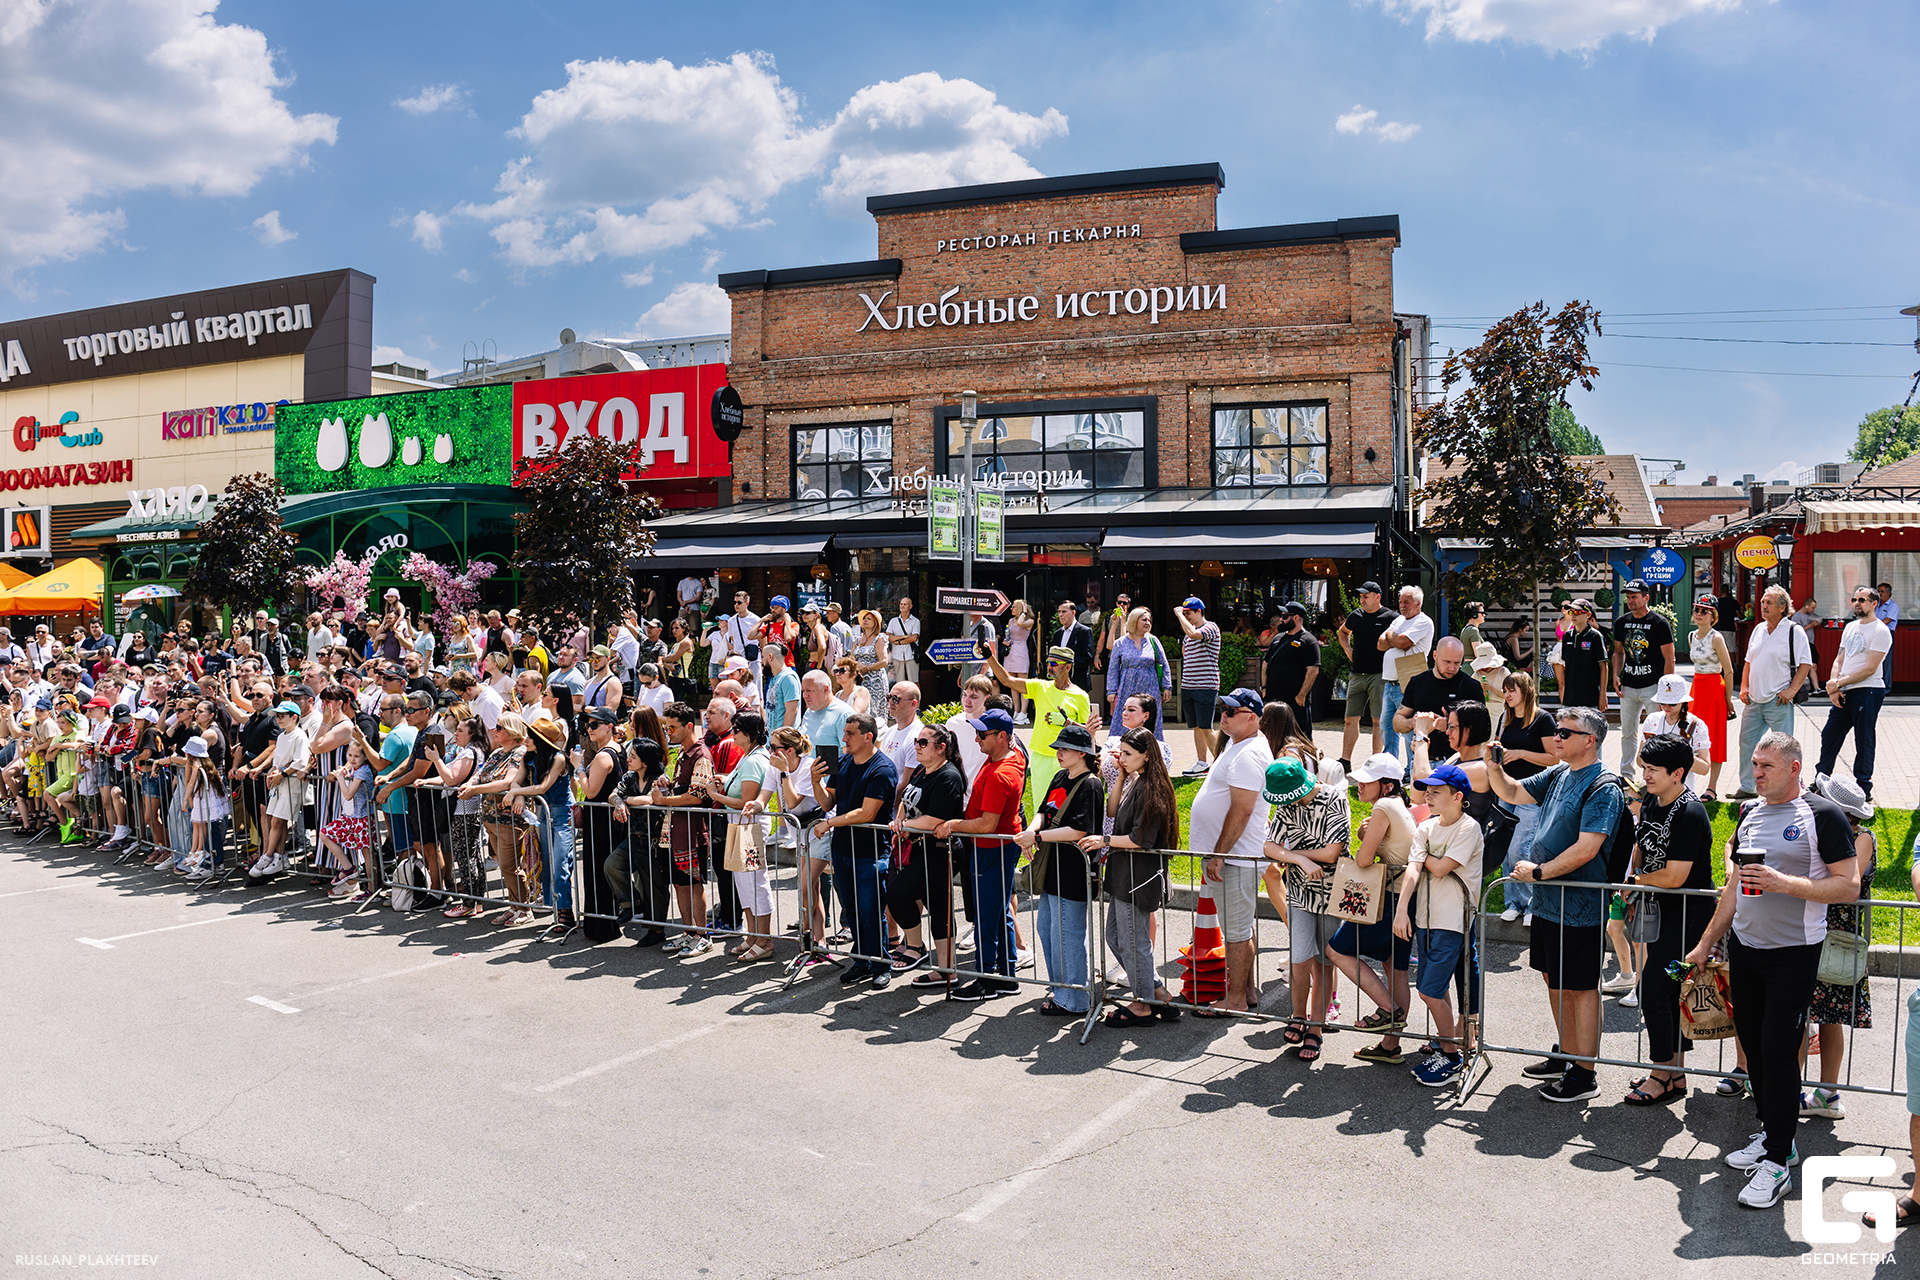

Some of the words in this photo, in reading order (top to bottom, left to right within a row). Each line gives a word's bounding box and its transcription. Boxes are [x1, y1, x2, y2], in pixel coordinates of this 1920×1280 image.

[937, 229, 1037, 253] РЕСТОРАН
[1048, 223, 1142, 243] ПЕКАРНЯ
[856, 286, 1039, 332] Хлебные
[1056, 283, 1228, 324] истории
[63, 311, 190, 366] торговый
[195, 303, 312, 345] квартал
[162, 406, 217, 440] kari
[219, 399, 289, 425] KID
[523, 392, 689, 466] ВХОД
[983, 468, 1084, 493] истории
[1754, 568, 1766, 576] 20
[1693, 1025, 1734, 1036] ROSTIC'S
